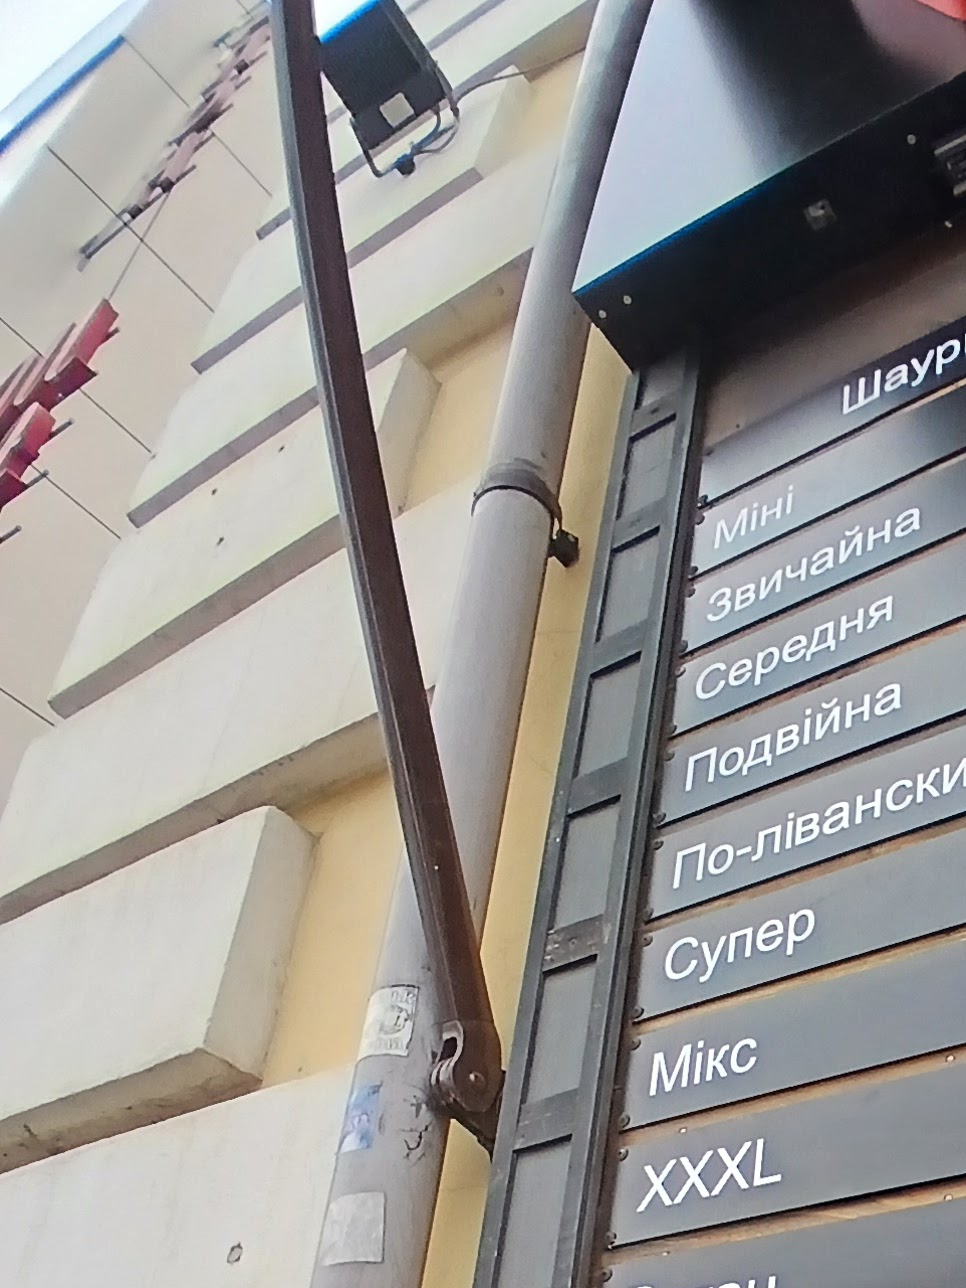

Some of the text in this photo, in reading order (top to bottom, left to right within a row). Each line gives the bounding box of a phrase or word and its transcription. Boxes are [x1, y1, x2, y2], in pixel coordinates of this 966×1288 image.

[712, 486, 794, 549] Міні
[705, 503, 922, 623] Звичайна
[694, 594, 895, 702] Середня
[684, 681, 902, 792] Подвійна
[664, 908, 816, 982] Супер
[648, 1037, 758, 1097] Мікс
[636, 1138, 783, 1213] XXXL
